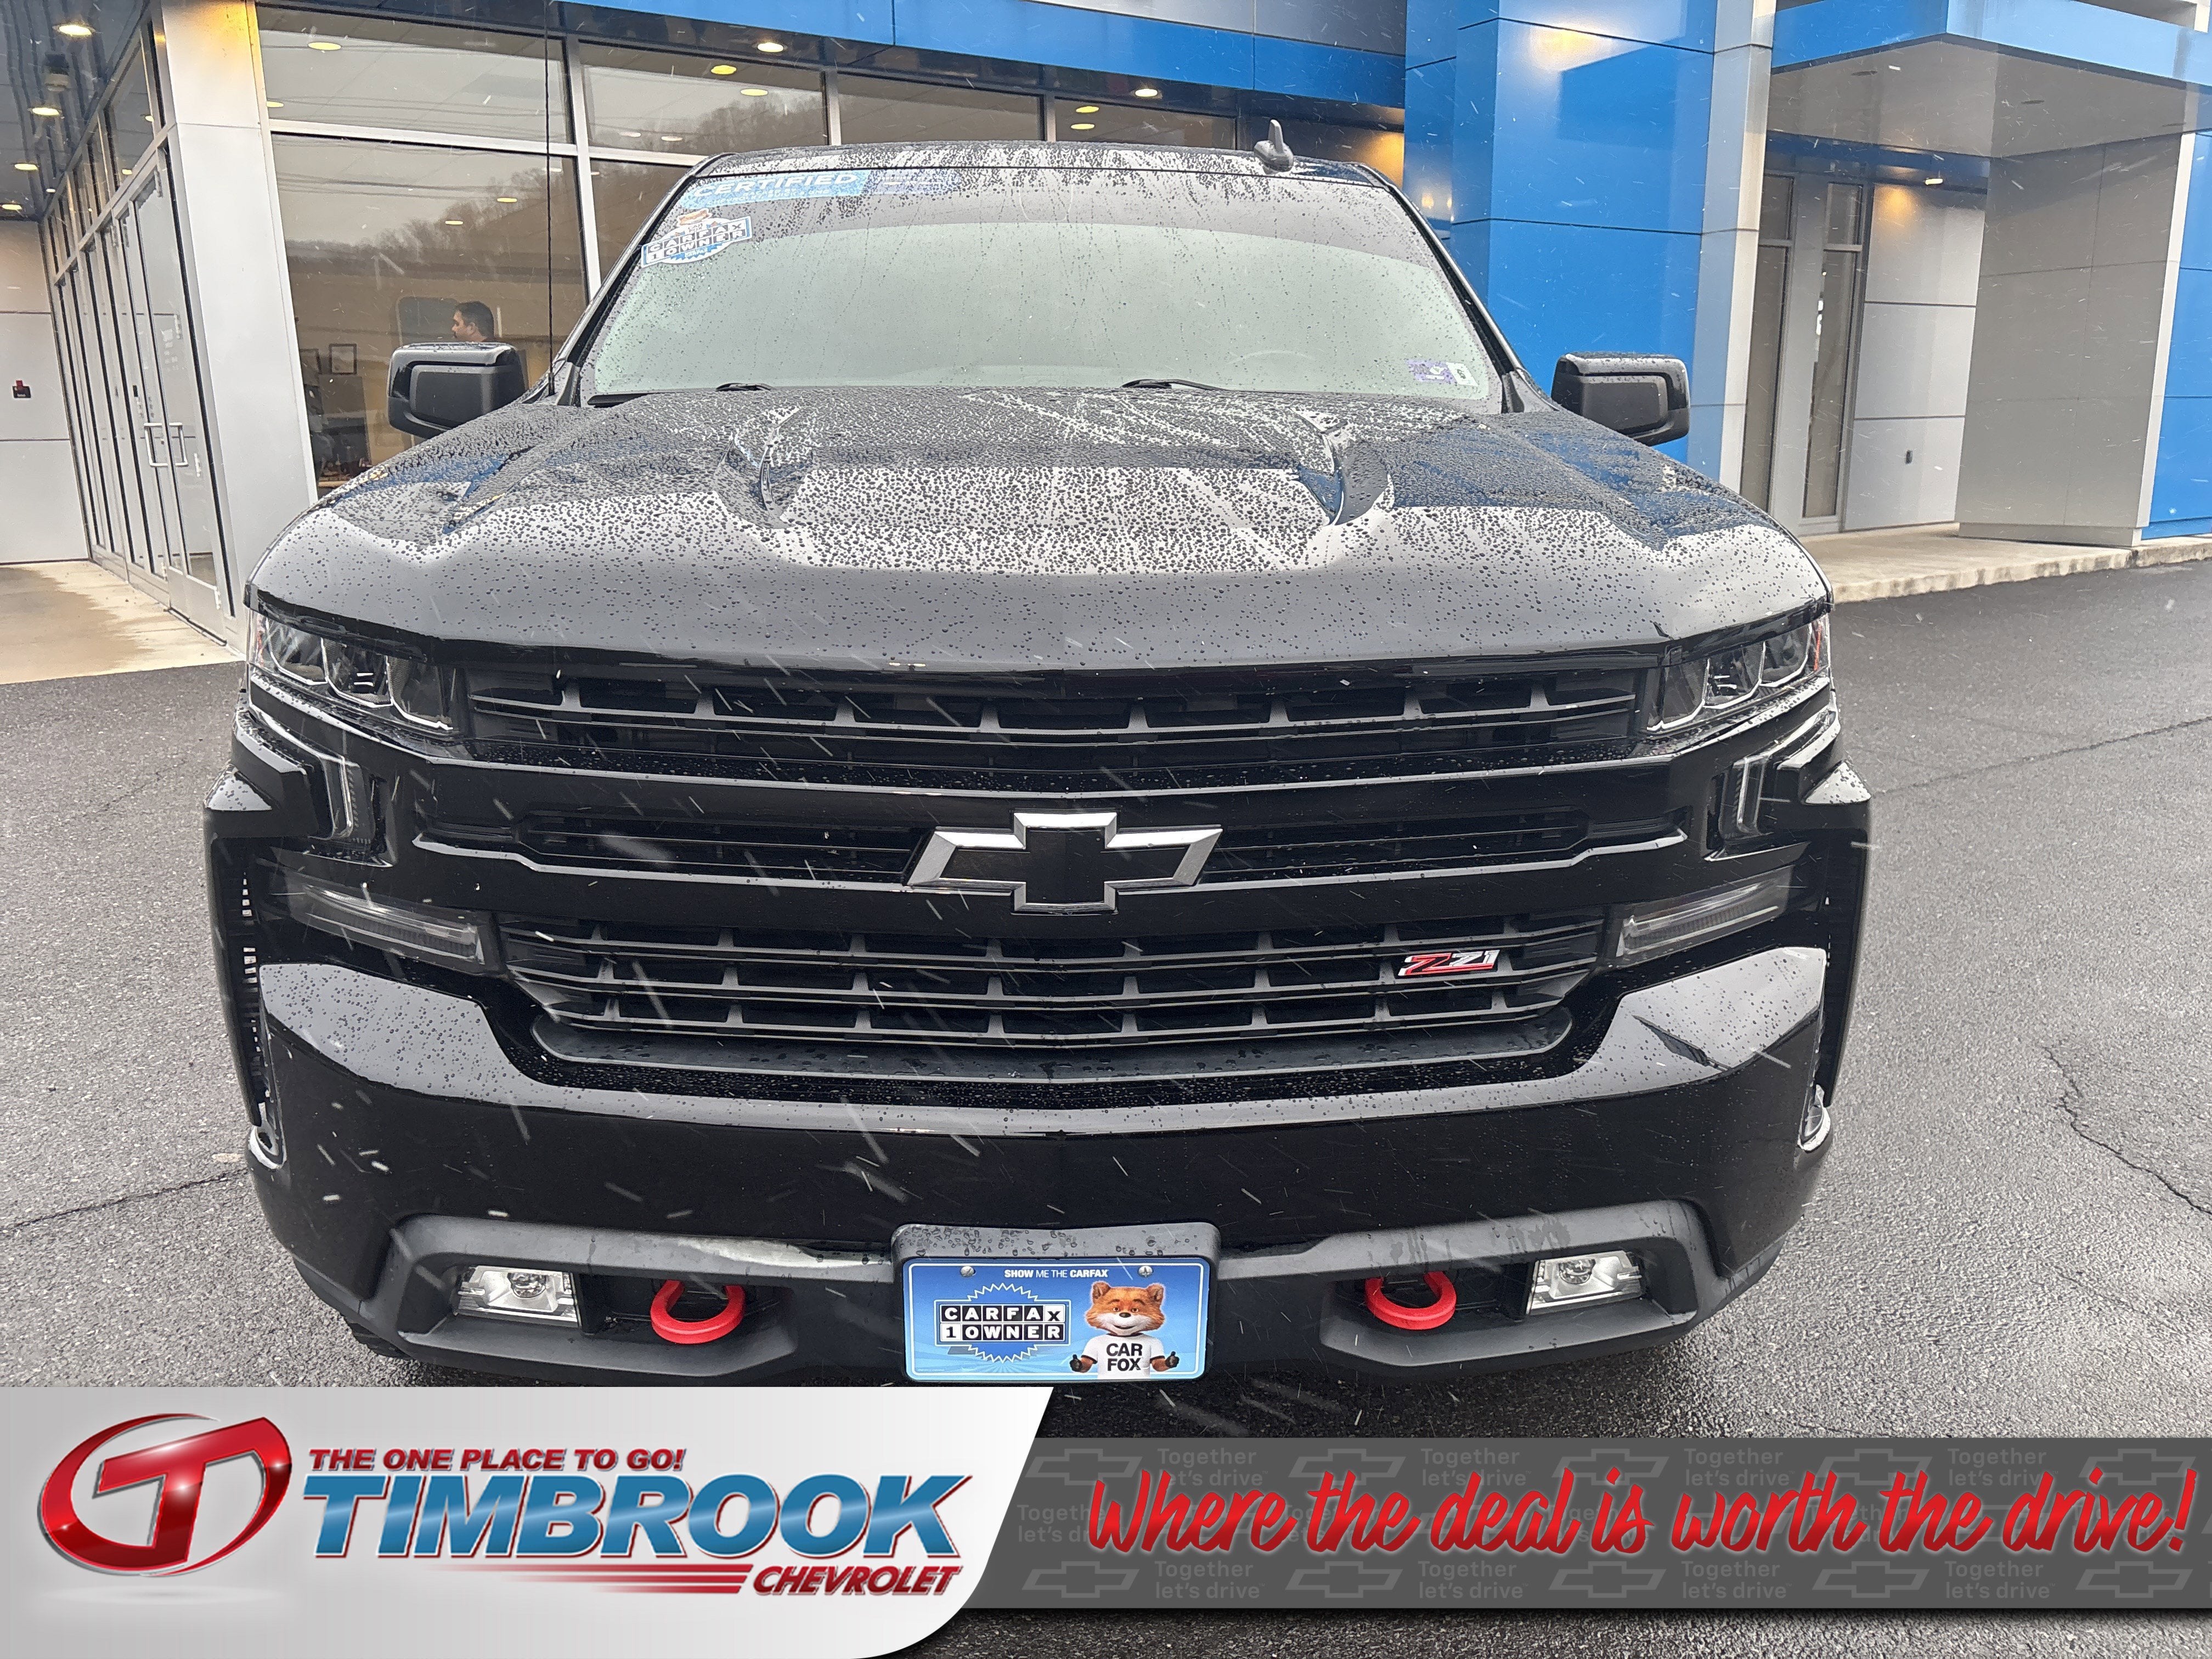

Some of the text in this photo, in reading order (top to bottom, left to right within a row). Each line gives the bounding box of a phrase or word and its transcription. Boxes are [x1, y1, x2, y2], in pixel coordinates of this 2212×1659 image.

[694, 174, 856, 196] CERTIFIED
[650, 223, 742, 252] CARFAX
[666, 230, 743, 256] OWNER
[1398, 950, 1500, 976] Z71
[1005, 1269, 1109, 1278] SHOW ME THE CARFAX
[945, 1306, 1062, 1322] CARFAX
[1106, 1342, 1143, 1357] CAR
[1107, 1358, 1141, 1372] FOX
